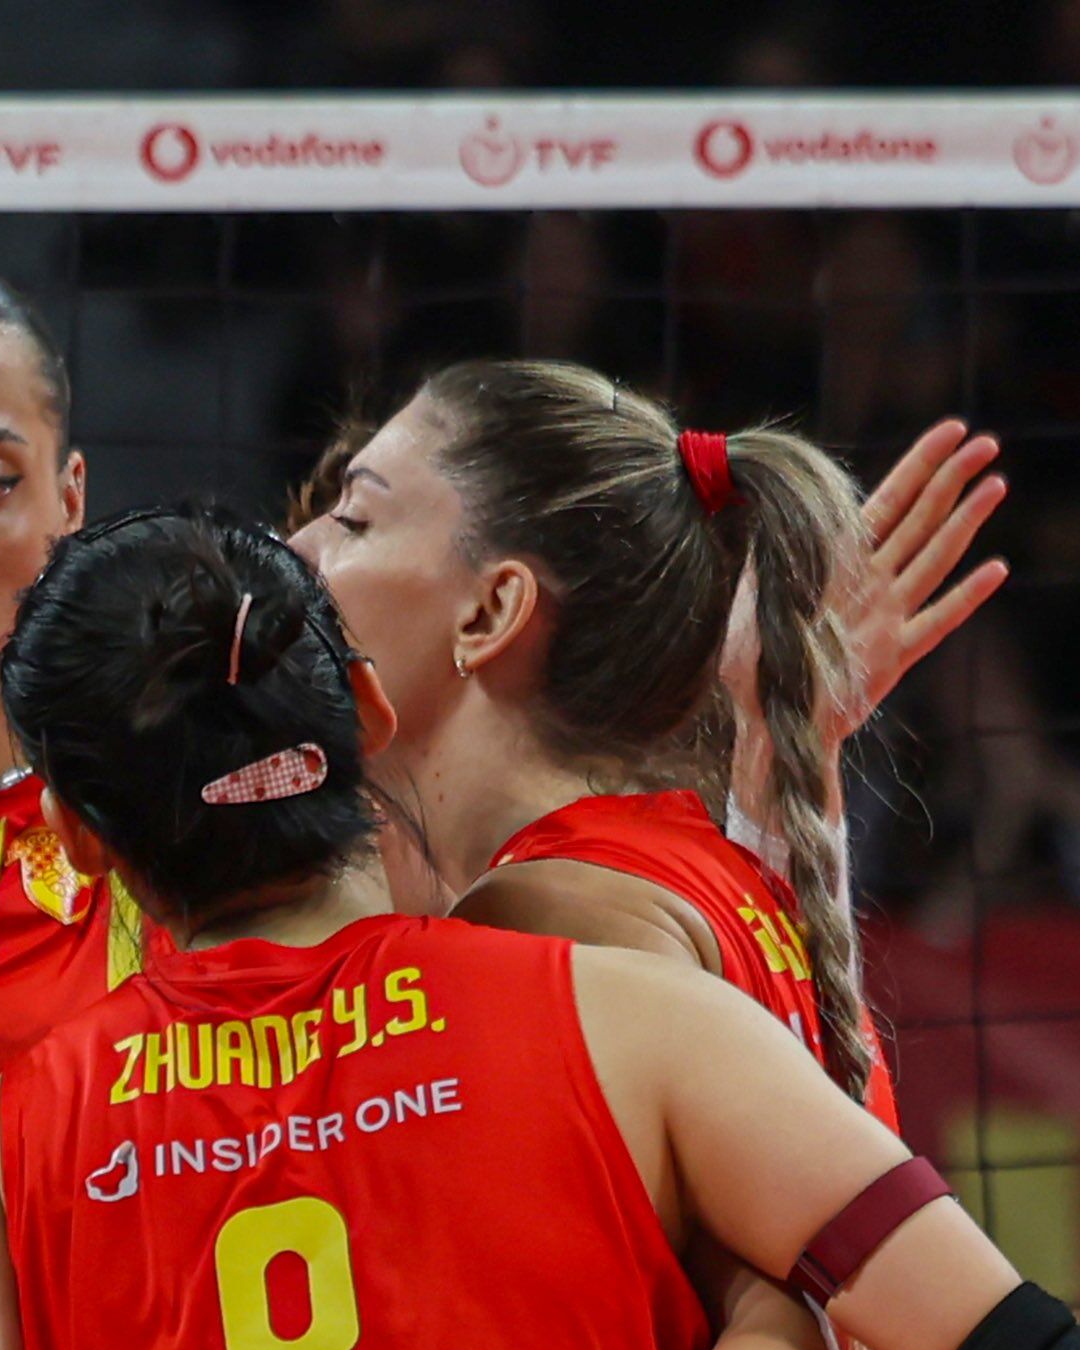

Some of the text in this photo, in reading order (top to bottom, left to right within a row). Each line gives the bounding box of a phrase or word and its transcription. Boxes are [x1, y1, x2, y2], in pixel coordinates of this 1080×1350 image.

[211, 134, 386, 166] vodafone
[533, 138, 618, 169] TVF
[764, 131, 937, 163] vodafone
[110, 966, 446, 1104] ZHUANG Y.S.
[155, 1078, 463, 1177] INSIDER ONE
